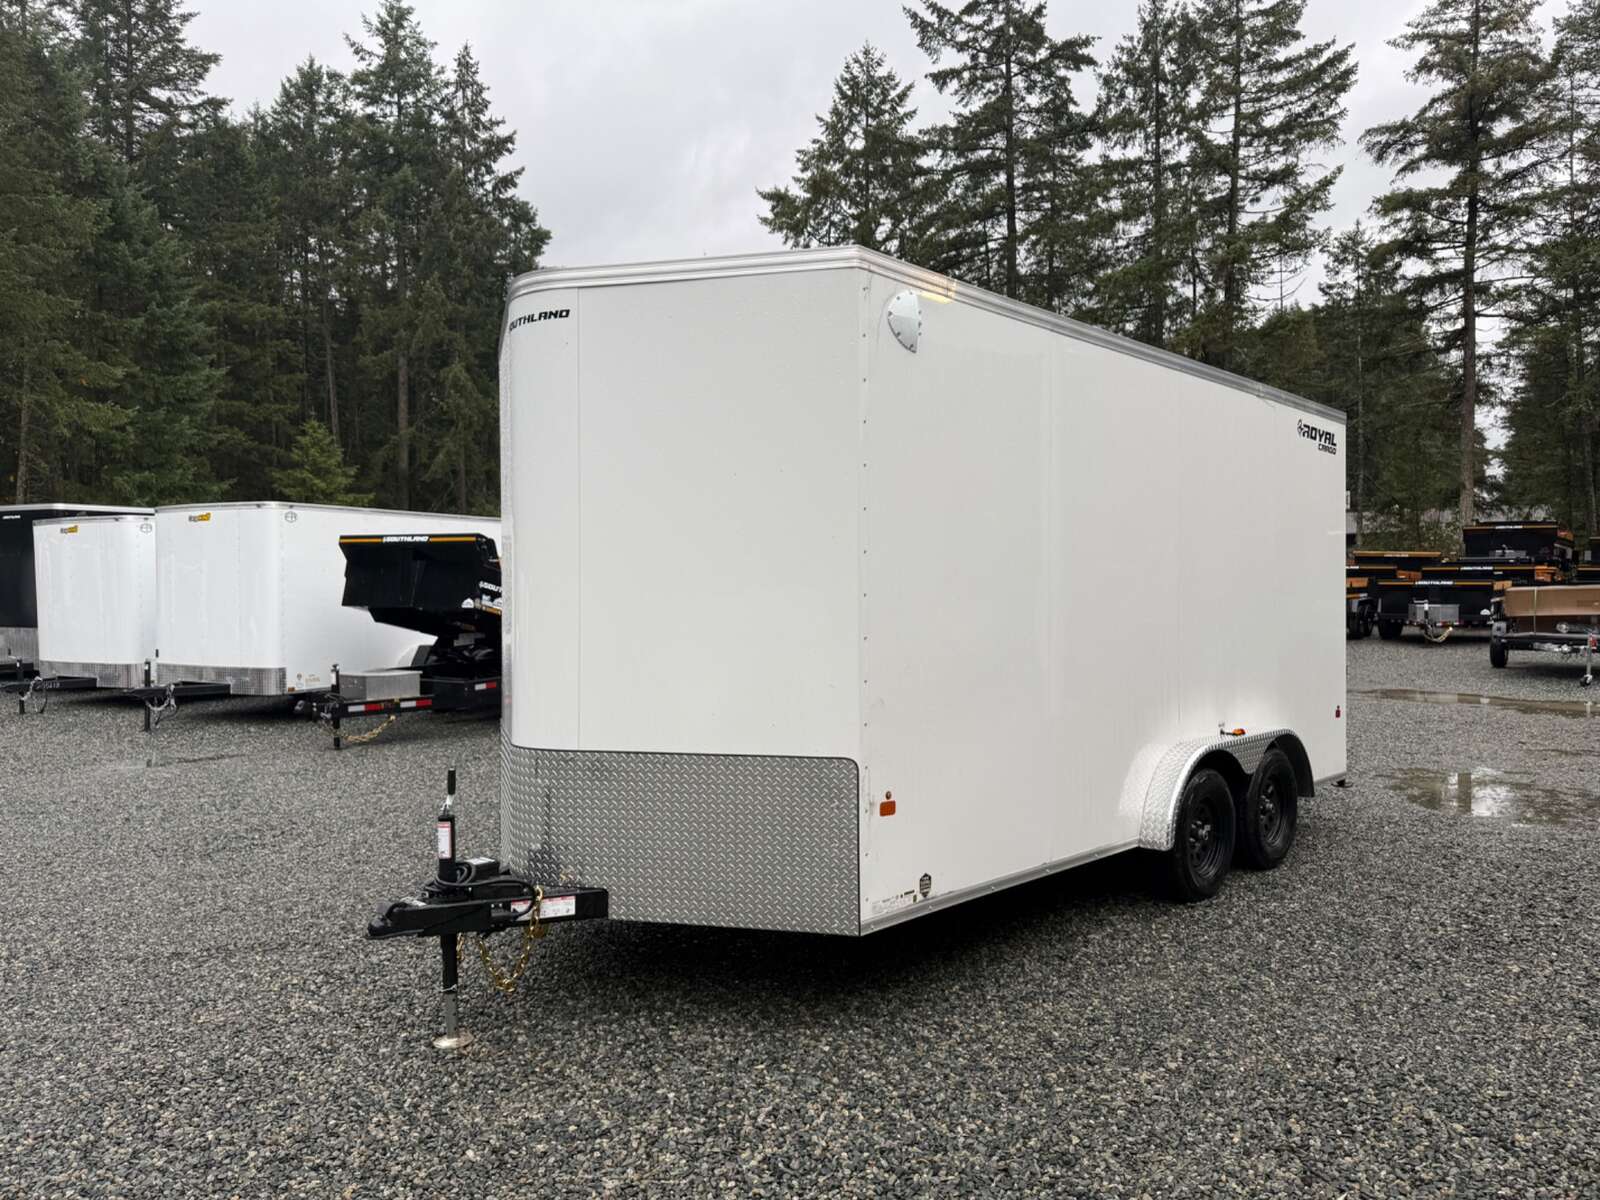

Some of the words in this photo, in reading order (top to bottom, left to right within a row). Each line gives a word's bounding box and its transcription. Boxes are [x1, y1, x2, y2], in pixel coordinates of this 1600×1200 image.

[509, 309, 571, 331] OUTHLAND
[1302, 423, 1337, 447] ROYAL
[385, 535, 429, 543] SOUTHLAND
